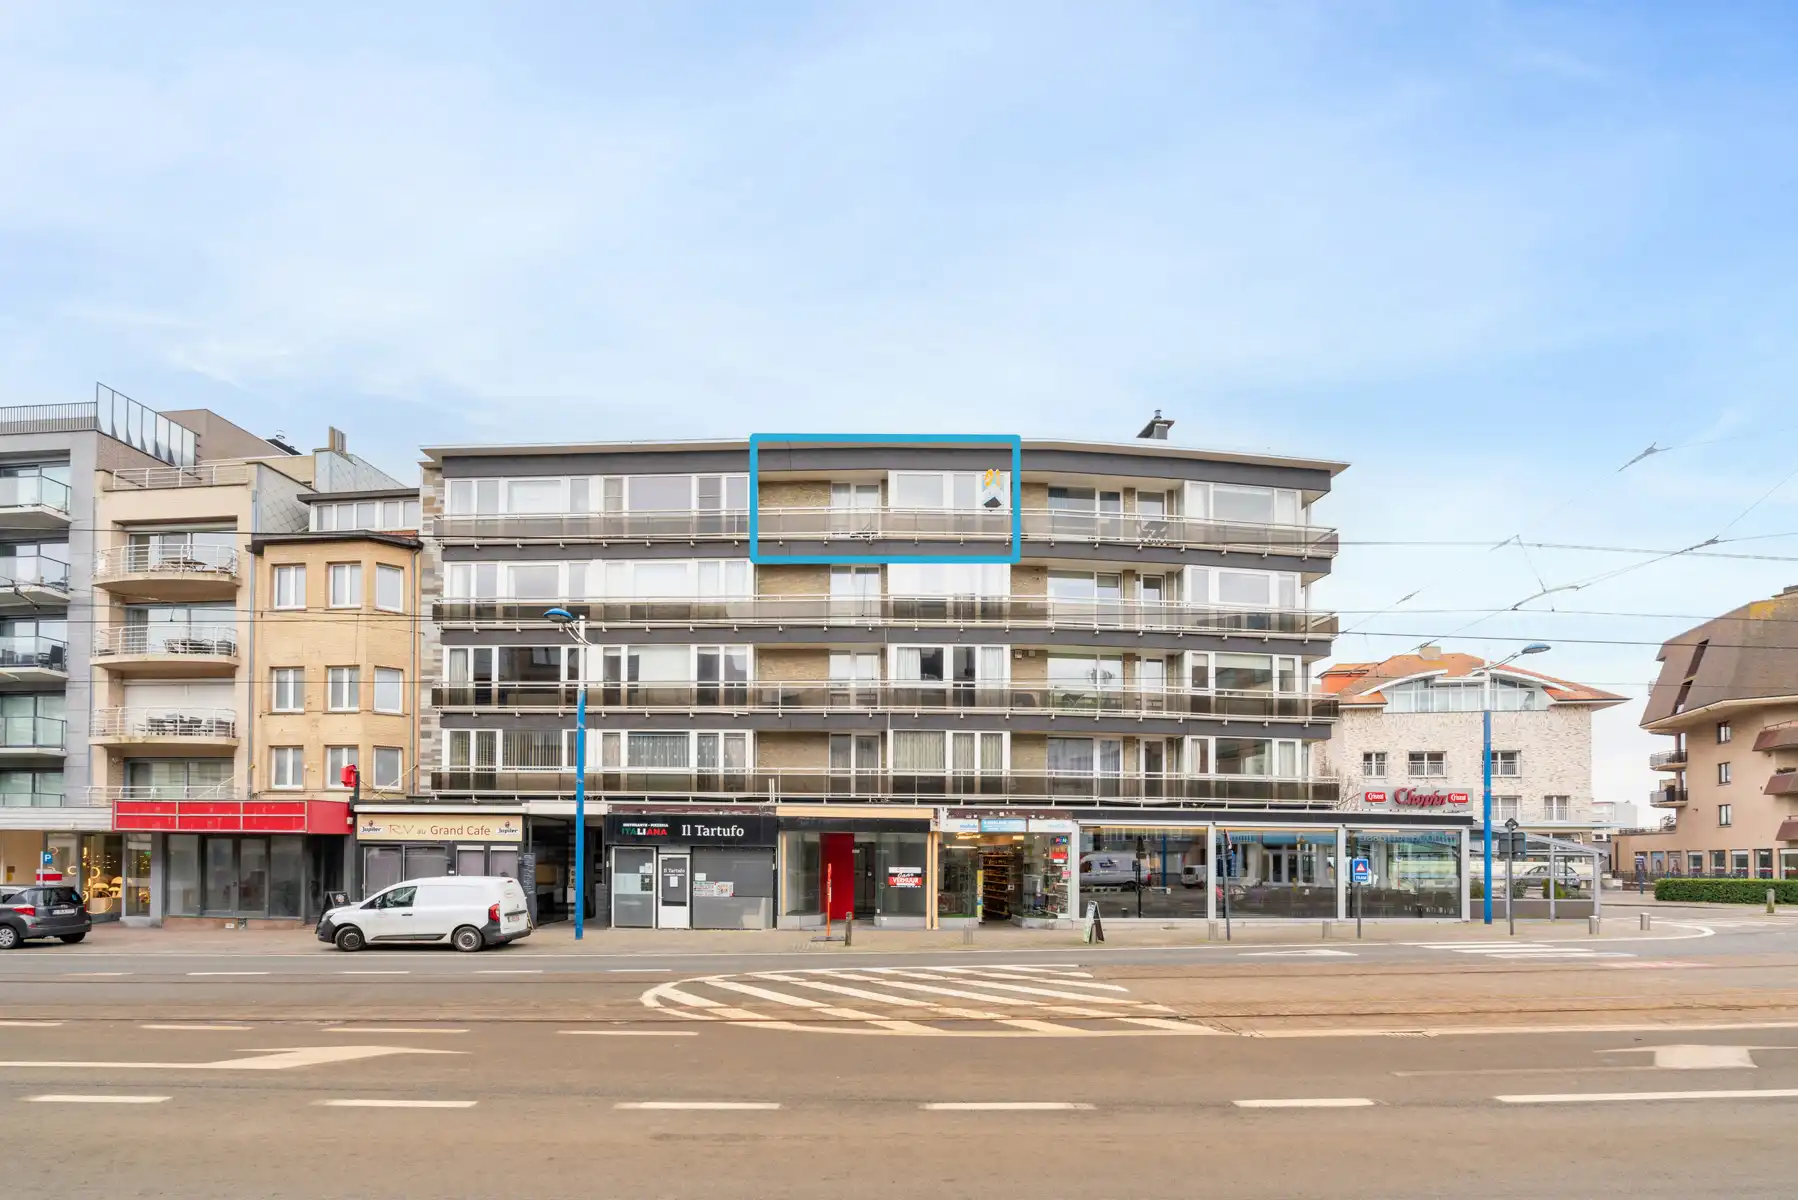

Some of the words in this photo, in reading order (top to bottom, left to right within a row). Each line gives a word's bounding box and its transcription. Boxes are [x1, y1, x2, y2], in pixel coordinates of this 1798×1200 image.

[430, 825, 464, 836] Grand
[466, 825, 491, 836] Cafe
[621, 827, 668, 836] ITALIANA
[681, 824, 691, 836] Il
[695, 824, 745, 837] Tartufo
[44, 854, 52, 862] P
